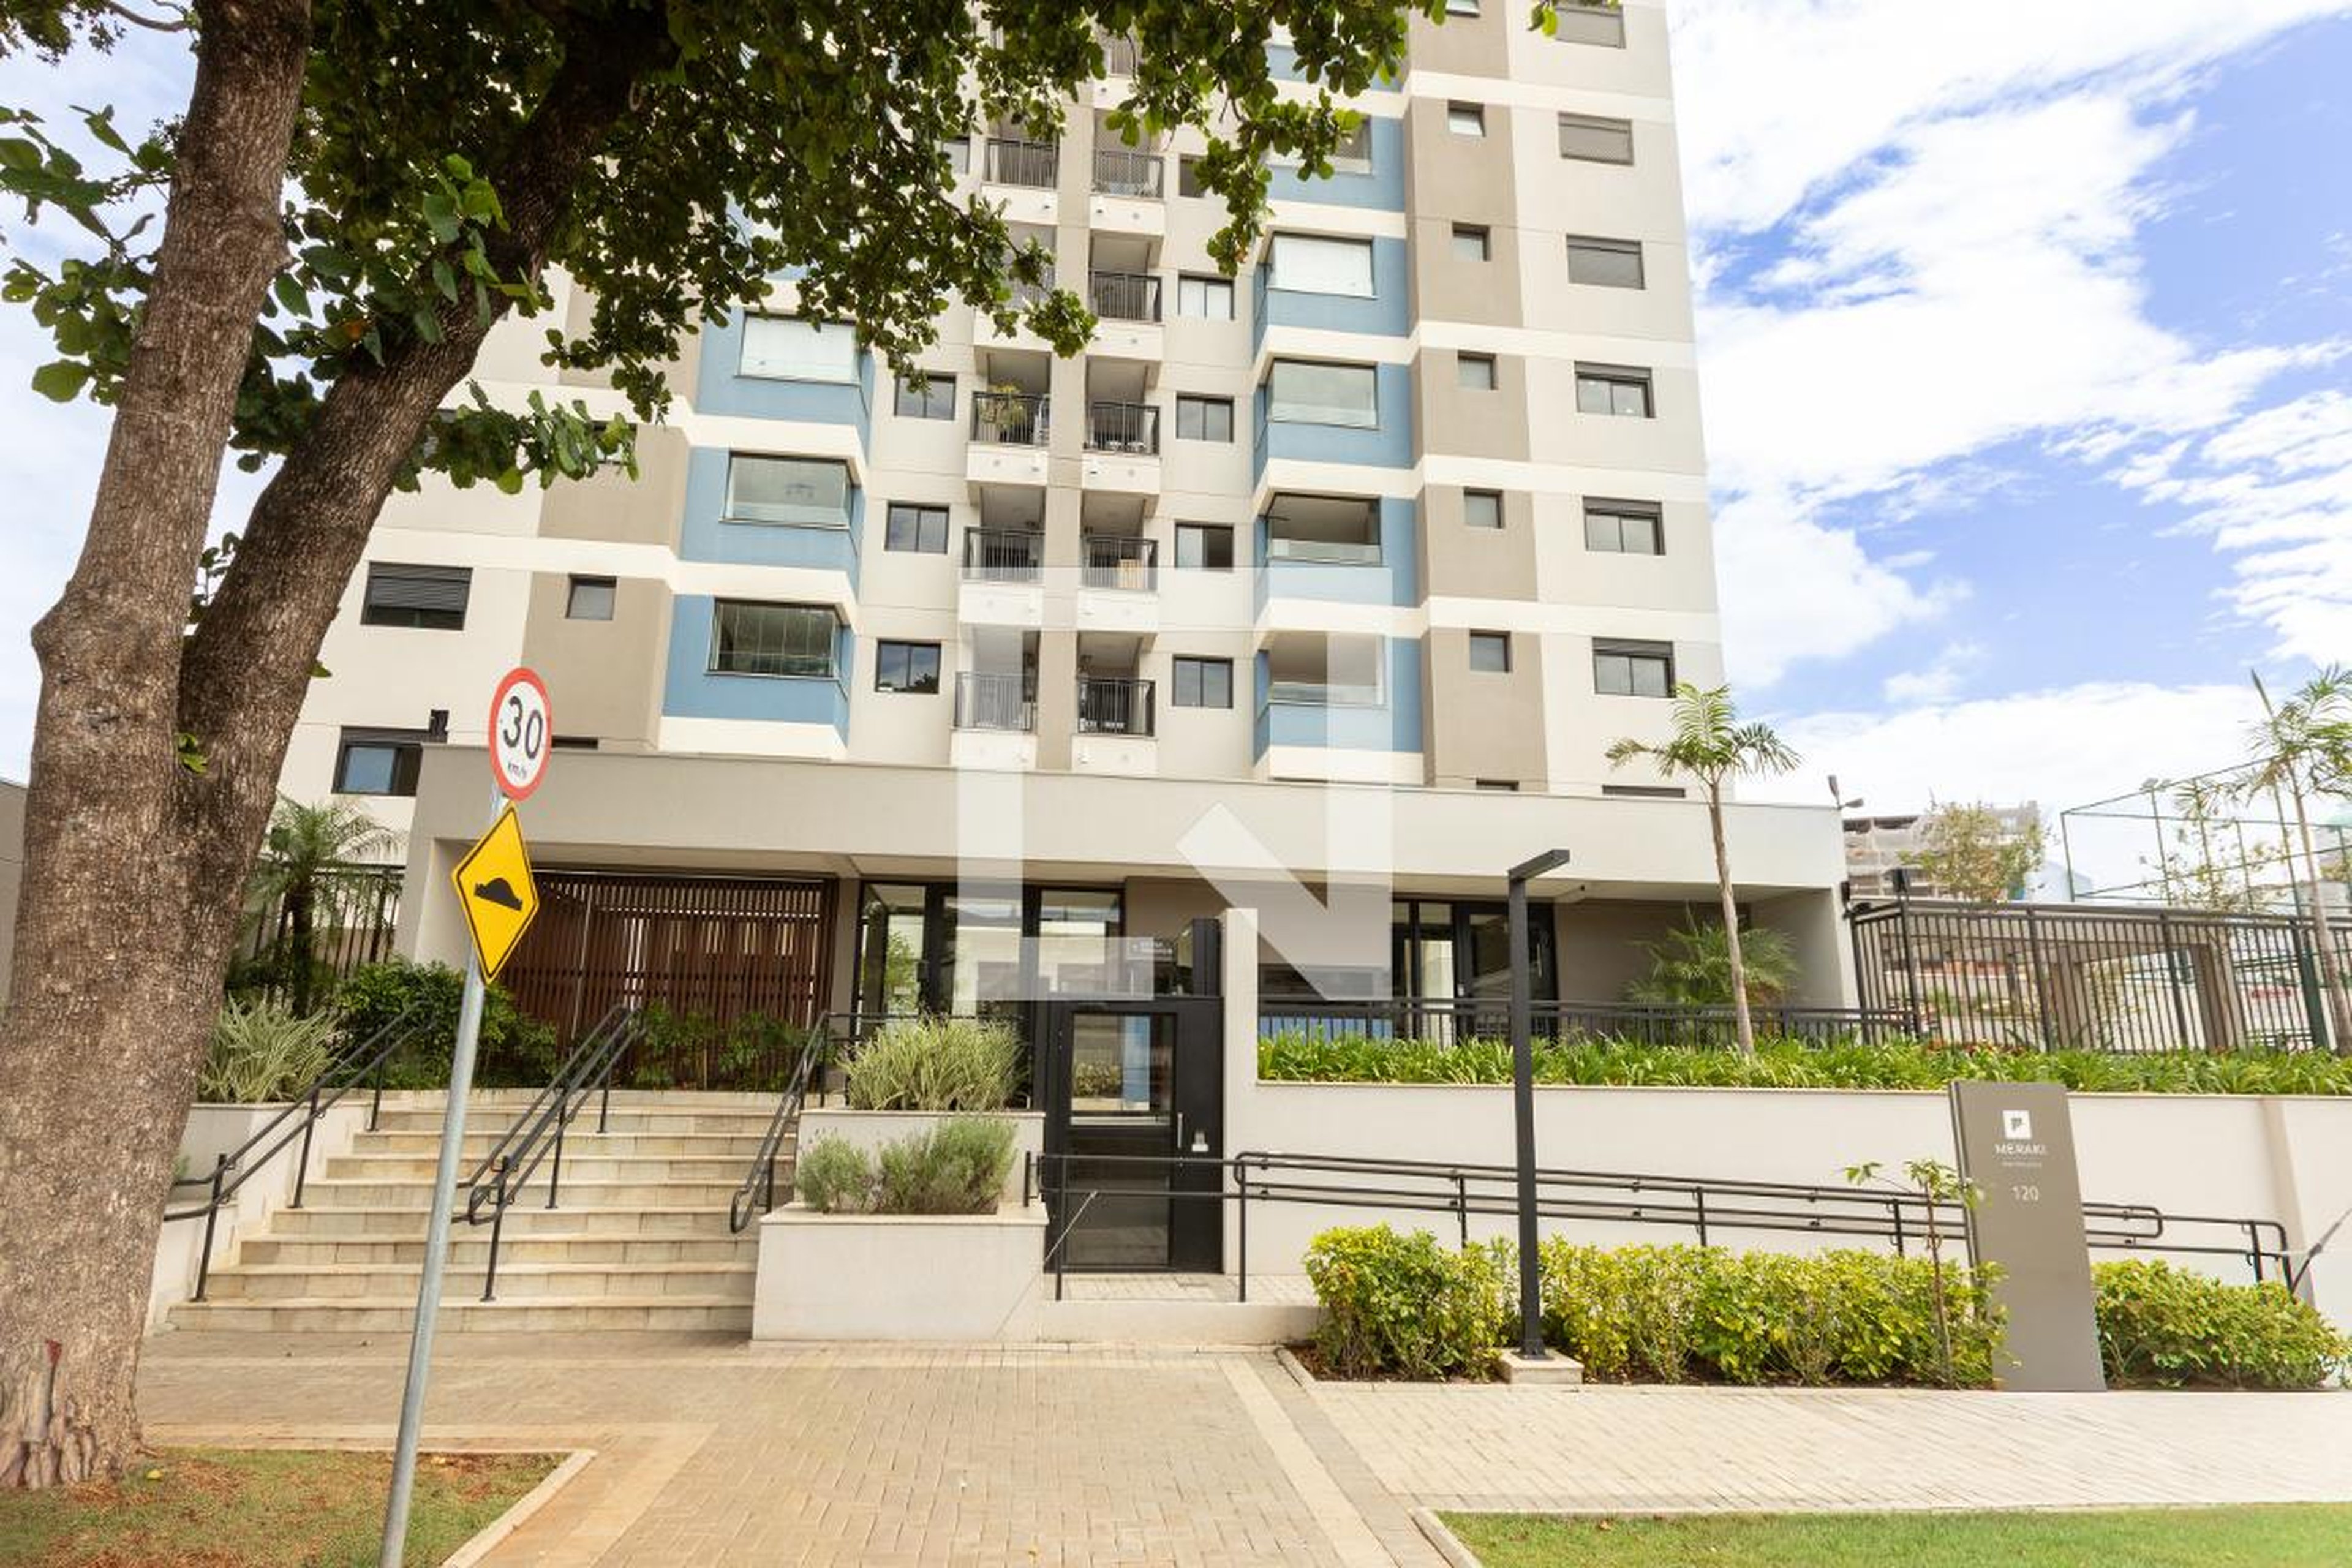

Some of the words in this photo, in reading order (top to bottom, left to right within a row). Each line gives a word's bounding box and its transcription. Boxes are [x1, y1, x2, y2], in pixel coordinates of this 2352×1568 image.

[503, 696, 543, 760] 30
[1994, 1143, 2049, 1155] MERAKI
[2012, 1186, 2039, 1202] 120
